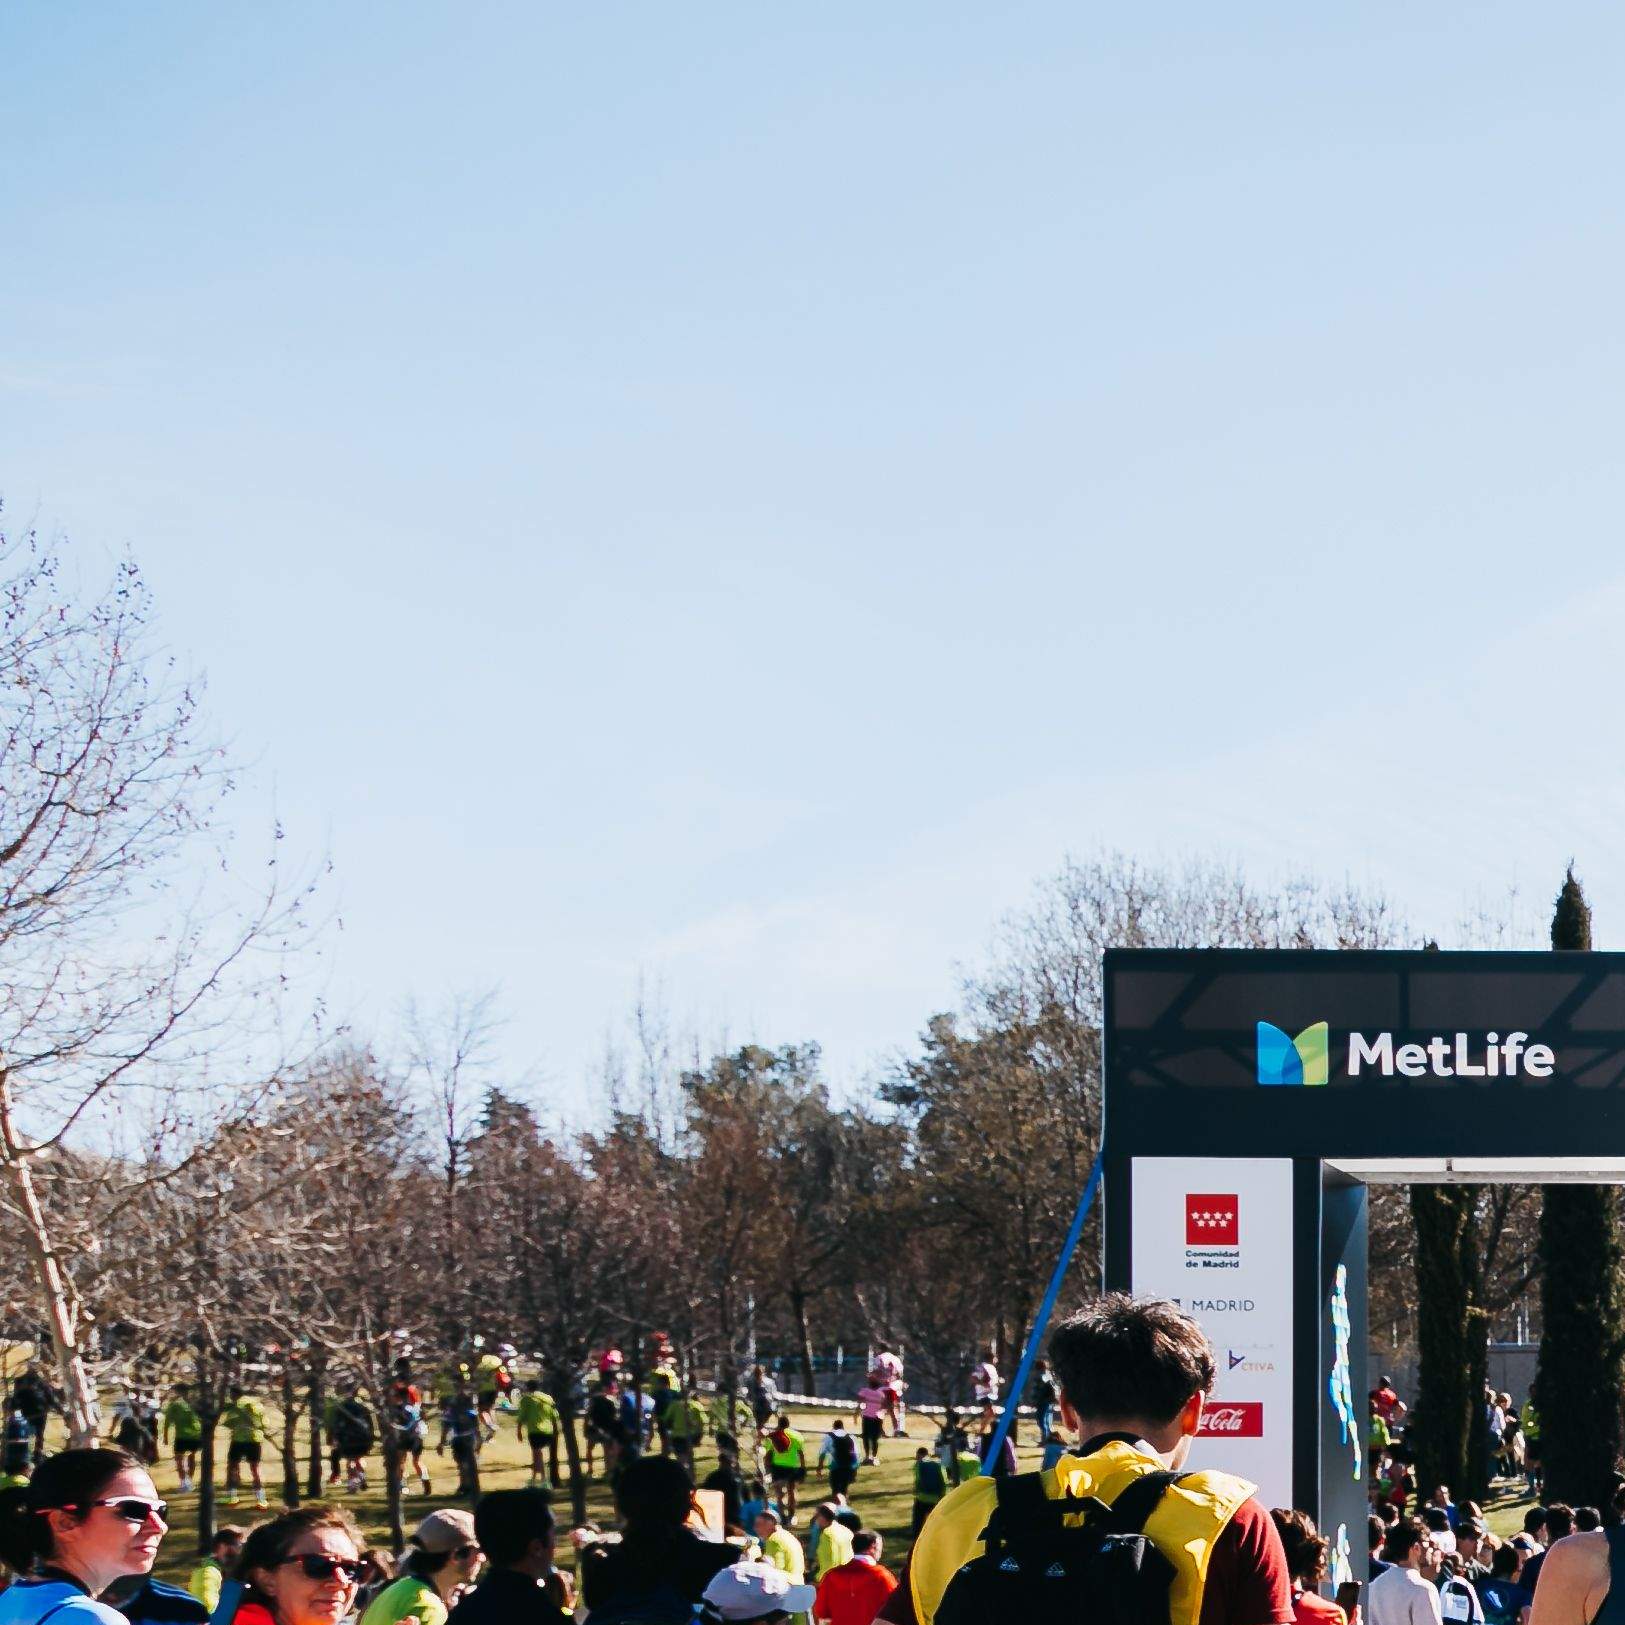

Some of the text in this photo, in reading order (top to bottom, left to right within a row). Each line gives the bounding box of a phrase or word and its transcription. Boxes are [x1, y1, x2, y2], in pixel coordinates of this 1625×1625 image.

[1348, 1031, 1555, 1077] MetLife
[1185, 1260, 1240, 1268] de Madrid
[1192, 1300, 1255, 1311] MADRID
